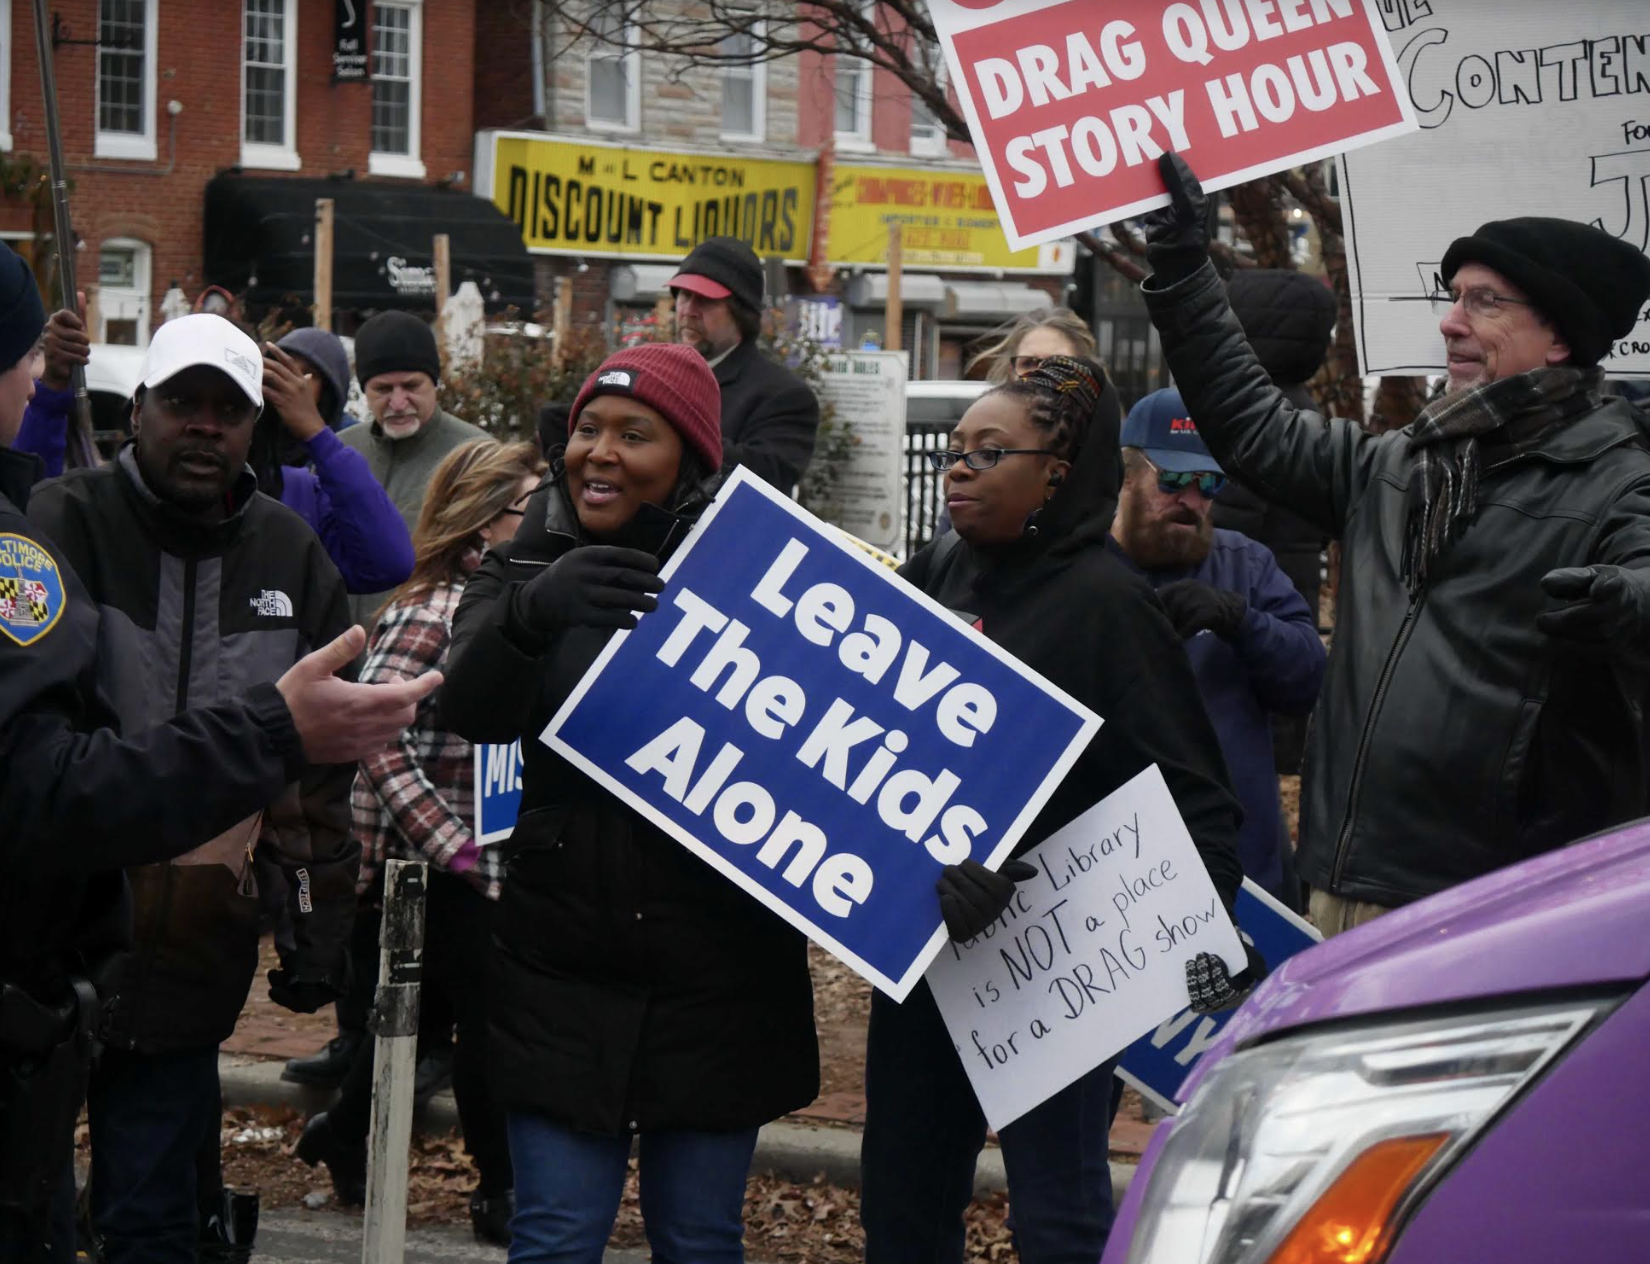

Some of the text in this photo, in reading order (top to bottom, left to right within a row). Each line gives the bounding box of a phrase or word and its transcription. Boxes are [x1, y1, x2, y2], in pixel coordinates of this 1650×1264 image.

[974, 20, 1146, 120] DRAG
[1005, 42, 1382, 199] STORY HOUR
[1620, 119, 1650, 145] FO
[508, 164, 663, 243] DISCOUNT
[674, 186, 799, 252] LIQUORS
[578, 156, 595, 176] M
[622, 160, 638, 181] L
[650, 161, 745, 187] CANTON
[0, 552, 41, 572] OLICE
[250, 597, 276, 607] NORTH
[261, 589, 275, 599] THE
[257, 606, 277, 616] FACE
[750, 537, 998, 747] Leave
[655, 587, 988, 865] The Kids
[624, 716, 874, 918] Alone
[1039, 812, 1141, 891] Library
[972, 860, 1178, 1008] is NOT a place
[971, 898, 1216, 1070] for a DRAG show
